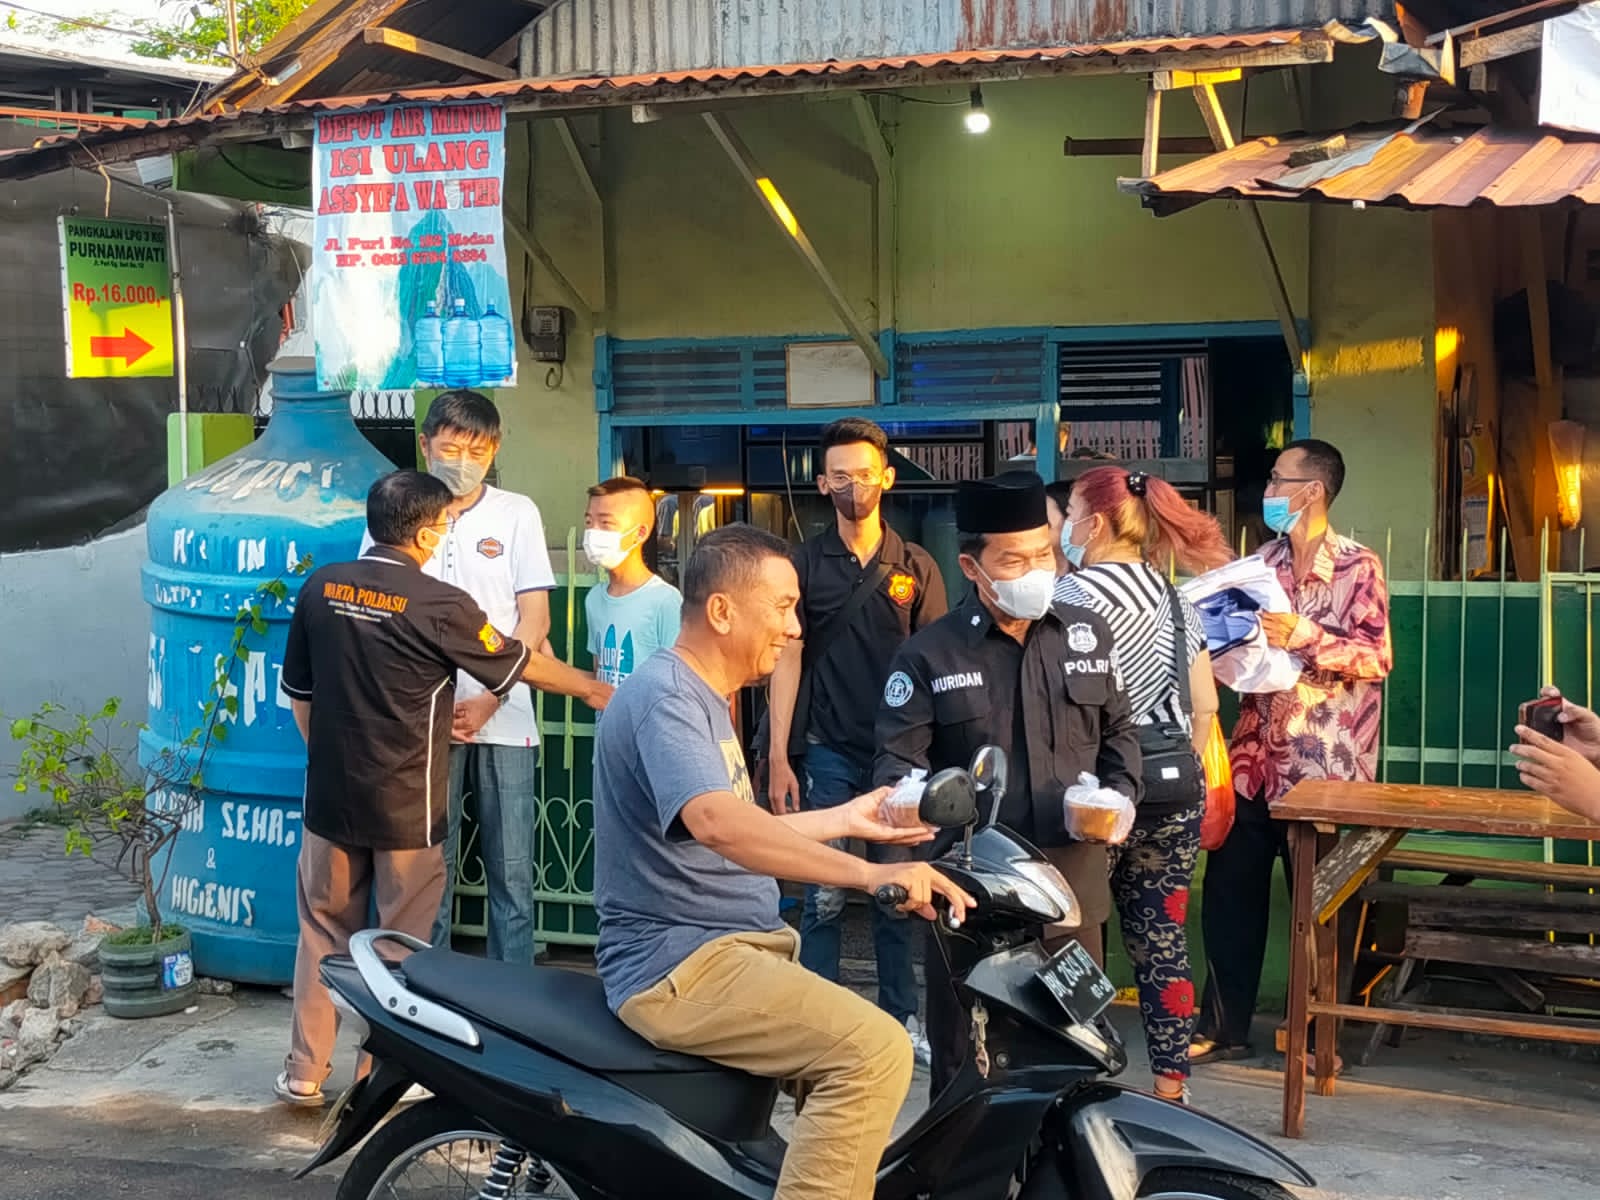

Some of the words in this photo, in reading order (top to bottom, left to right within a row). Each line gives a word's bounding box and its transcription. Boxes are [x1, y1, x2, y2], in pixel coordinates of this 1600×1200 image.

[318, 110, 385, 144] DEPOT
[391, 106, 426, 138] AIR
[431, 103, 502, 136] MINUM
[330, 146, 373, 177] ISI
[382, 140, 490, 174] ULANG
[318, 182, 410, 215] ASSYIFA
[68, 224, 123, 240] PANGKALAN
[69, 241, 165, 263] PURNAMAWATI
[336, 253, 366, 267] HP.
[323, 581, 355, 602] WARTA
[356, 587, 409, 614] POLDASU
[1064, 659, 1109, 675] POLRI
[931, 671, 983, 695] MURIDAN
[206, 847, 217, 869] &
